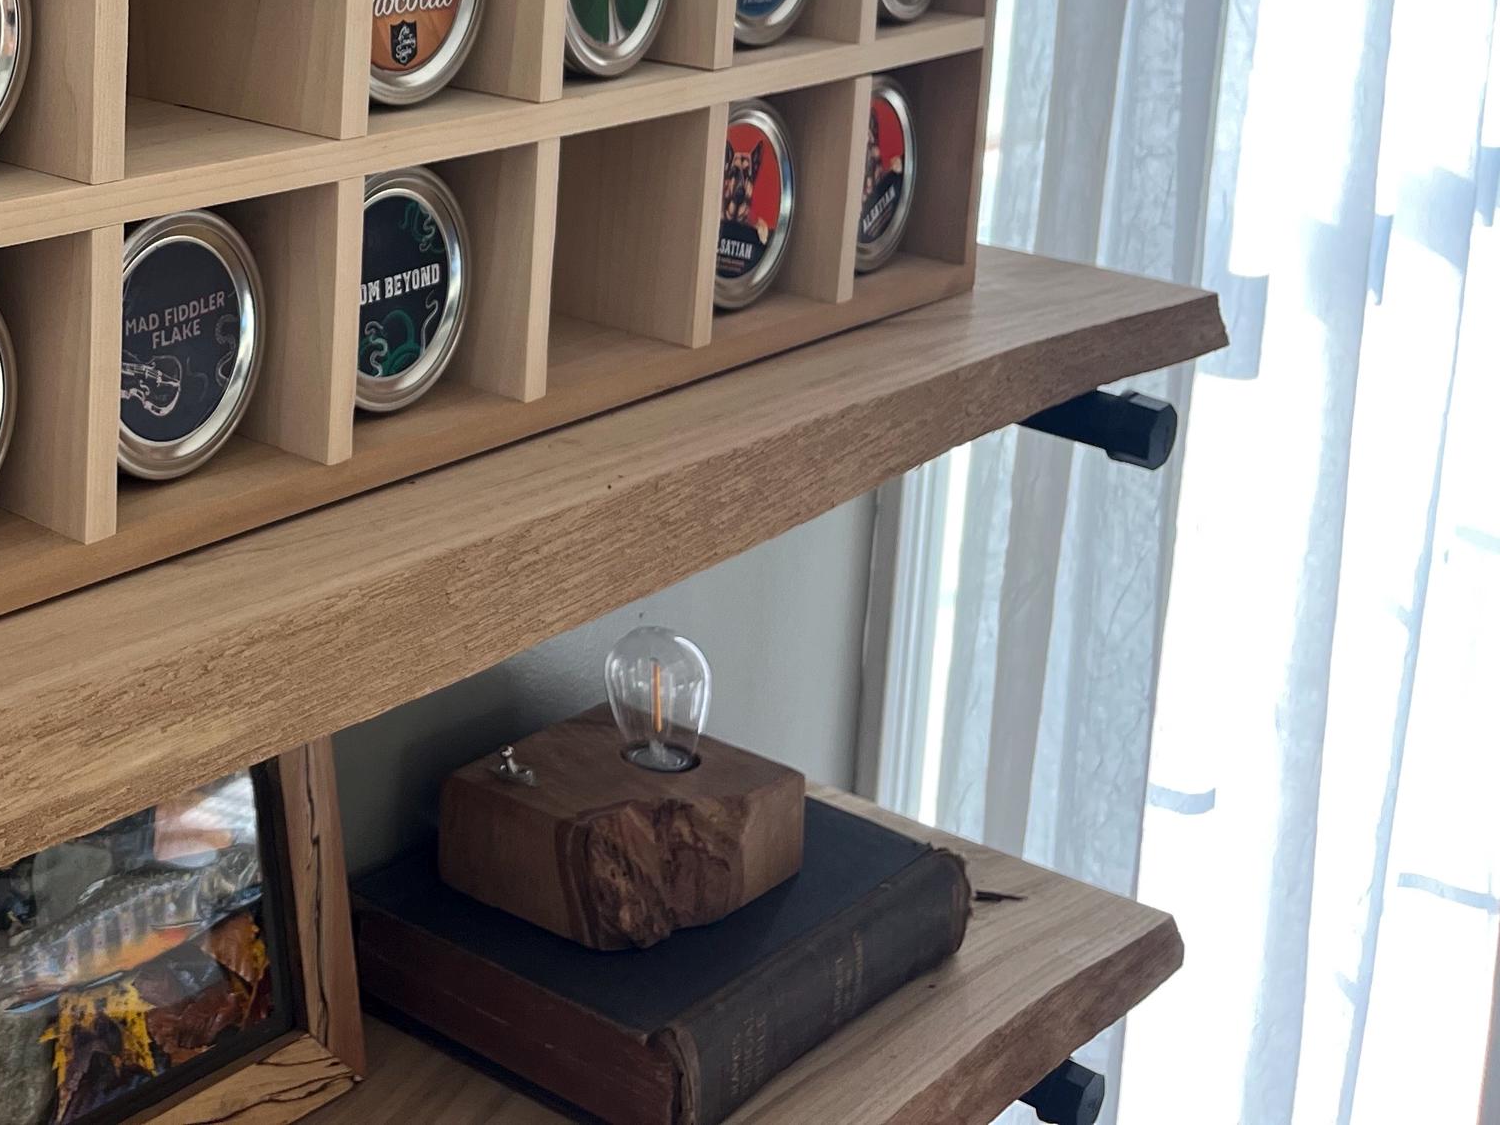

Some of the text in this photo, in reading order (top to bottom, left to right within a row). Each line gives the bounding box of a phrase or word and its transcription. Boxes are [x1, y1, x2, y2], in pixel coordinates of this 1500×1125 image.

[717, 237, 753, 260] SATIAN
[359, 262, 441, 306] OM BEYOND
[125, 290, 226, 337] MAD FIDDLER
[152, 318, 201, 350] FLAKE
